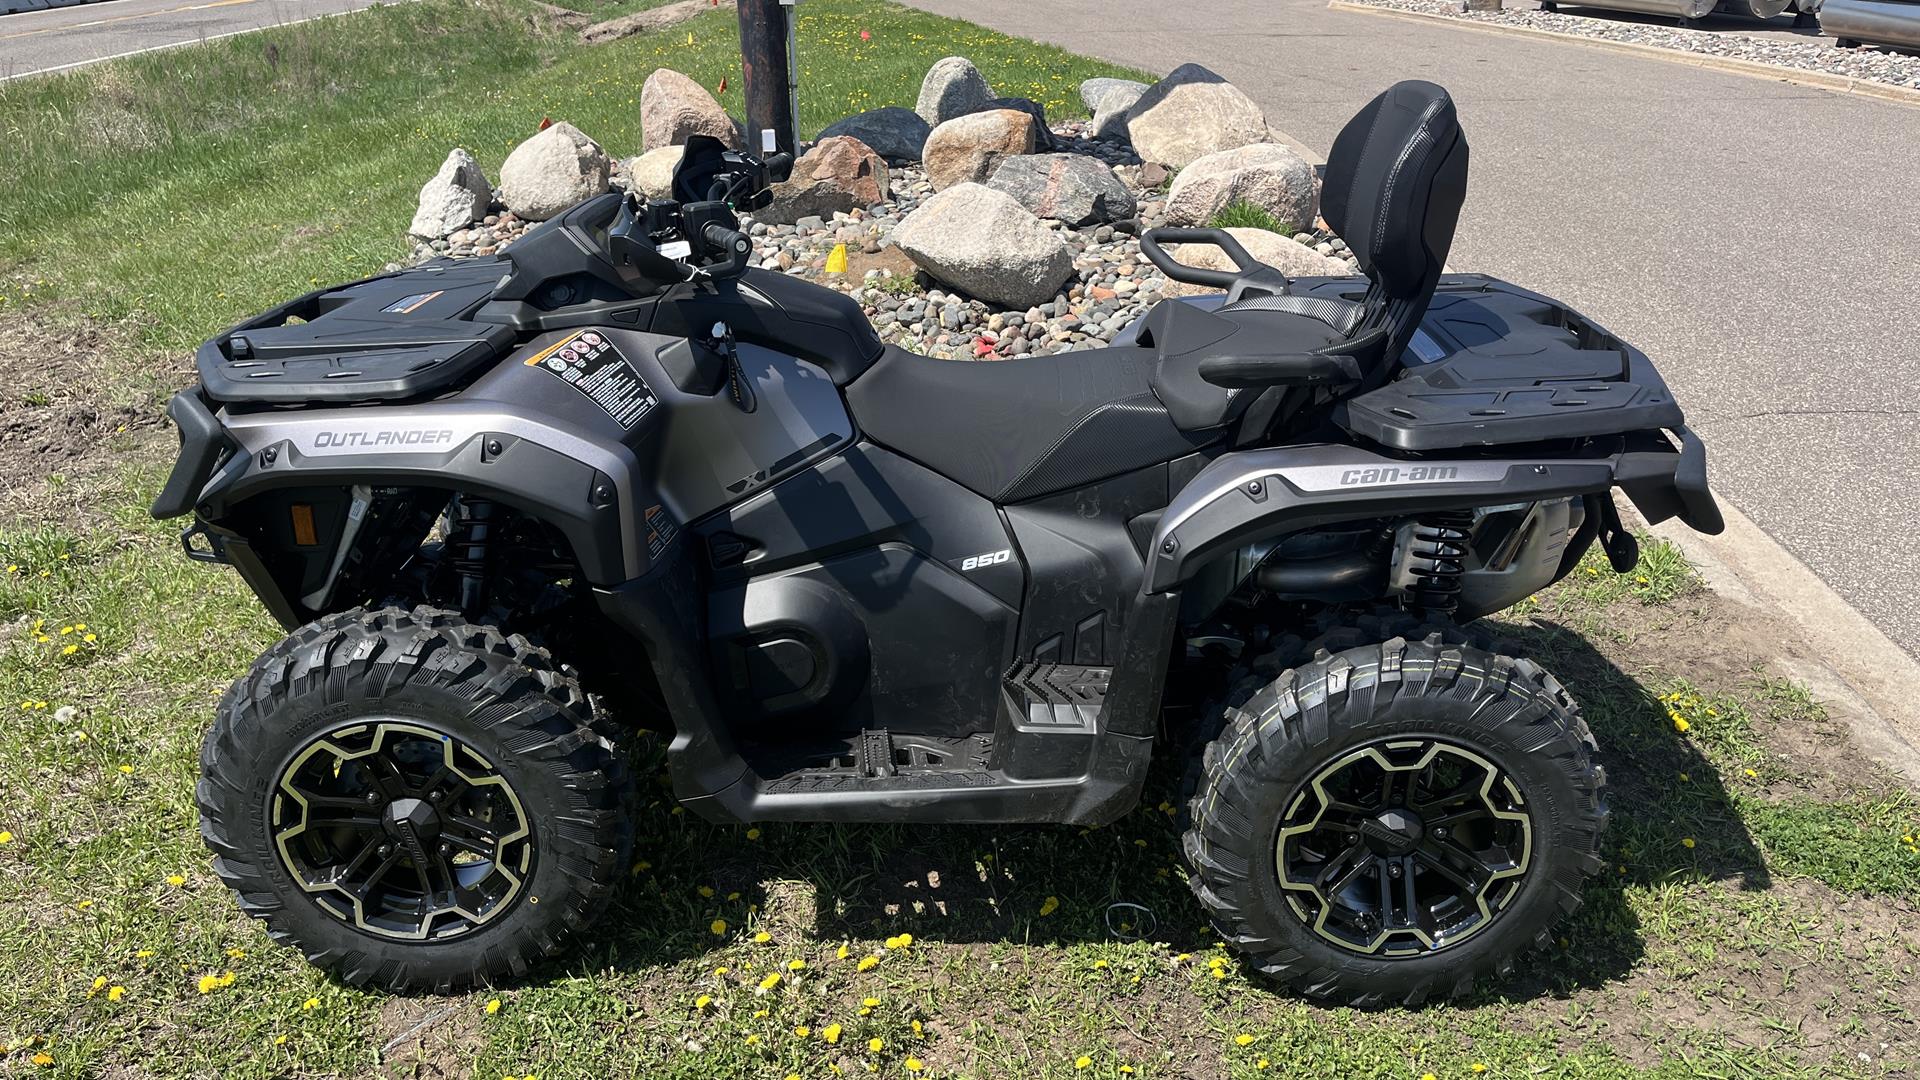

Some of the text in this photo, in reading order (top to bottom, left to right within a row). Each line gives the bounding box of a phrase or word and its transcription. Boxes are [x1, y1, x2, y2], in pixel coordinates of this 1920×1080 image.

[314, 430, 453, 447] OUTLANDER
[1340, 466, 1458, 485] can-am
[962, 549, 1010, 571] 850
